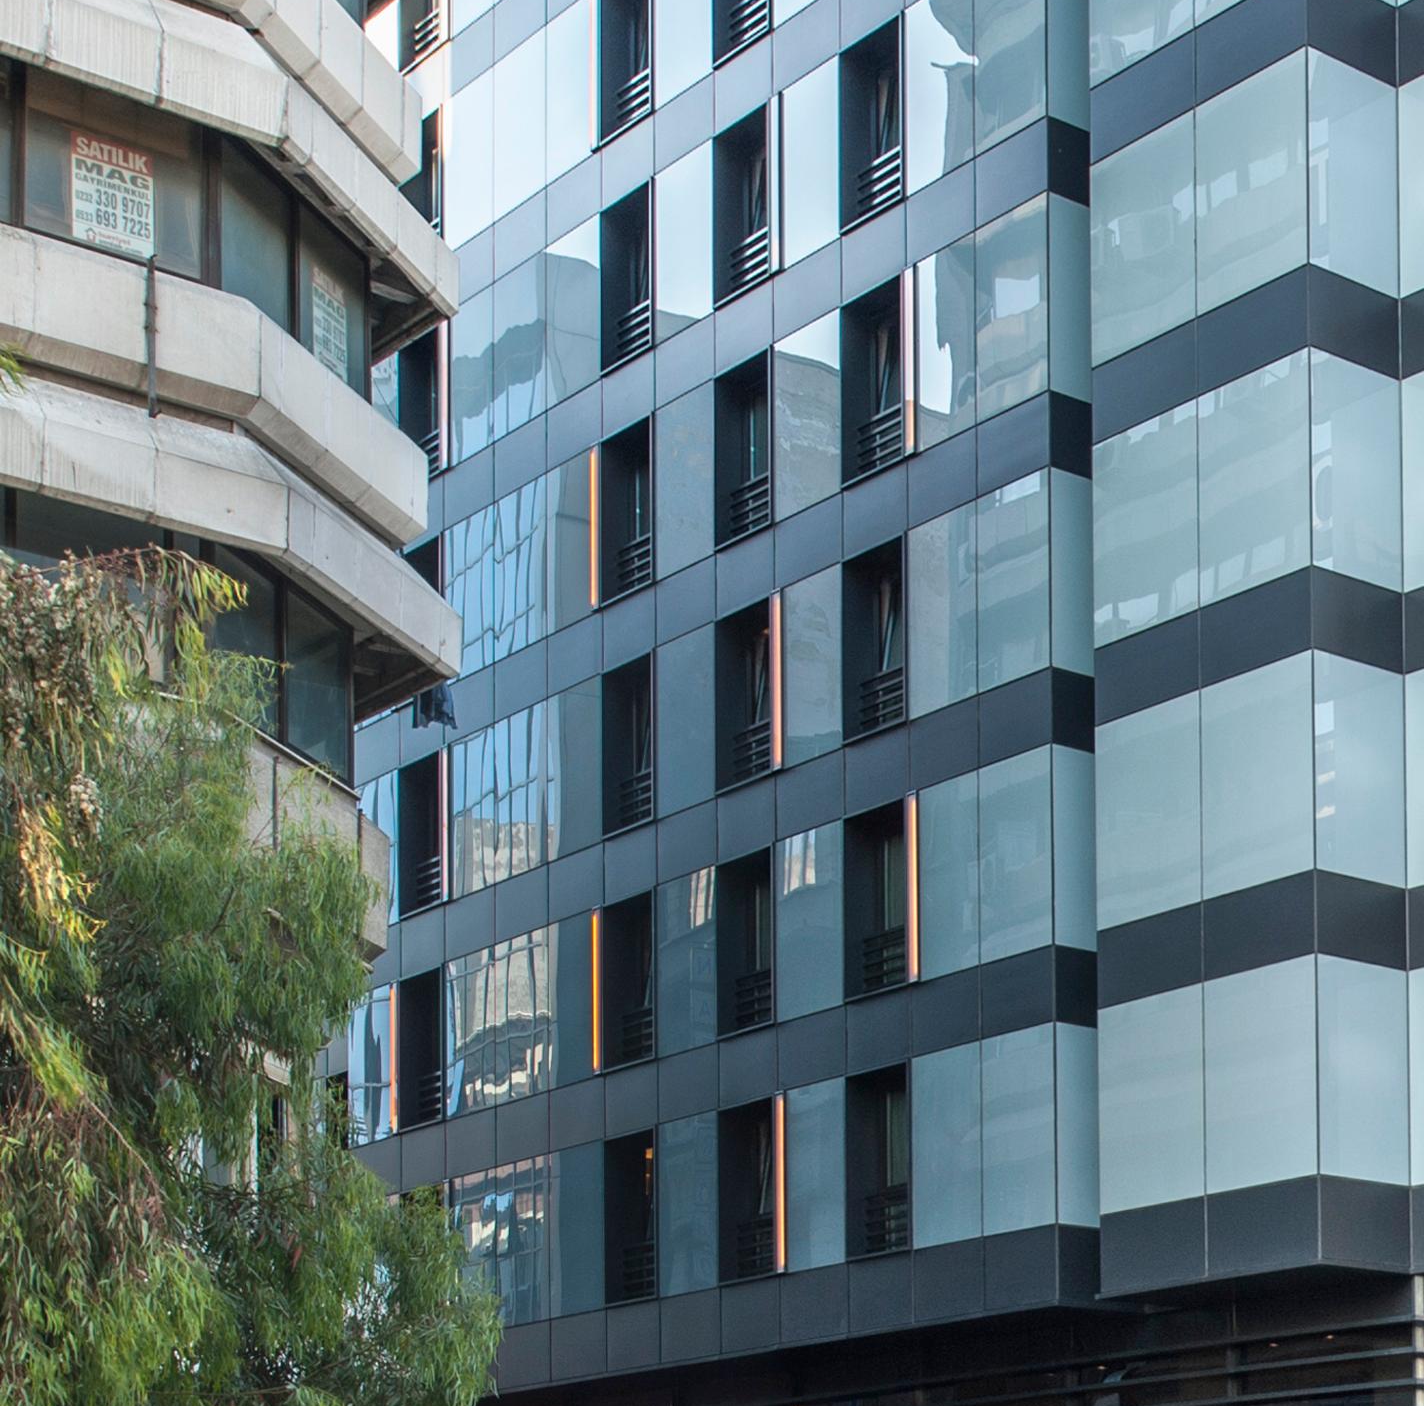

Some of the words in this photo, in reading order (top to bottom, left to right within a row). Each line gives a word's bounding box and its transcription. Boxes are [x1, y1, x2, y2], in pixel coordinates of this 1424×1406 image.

[76, 136, 148, 173] SATILIK
[75, 157, 149, 190] MAG
[95, 188, 118, 211] 330
[121, 195, 150, 220] 9707
[95, 208, 118, 230] 693
[121, 215, 150, 240] 7225
